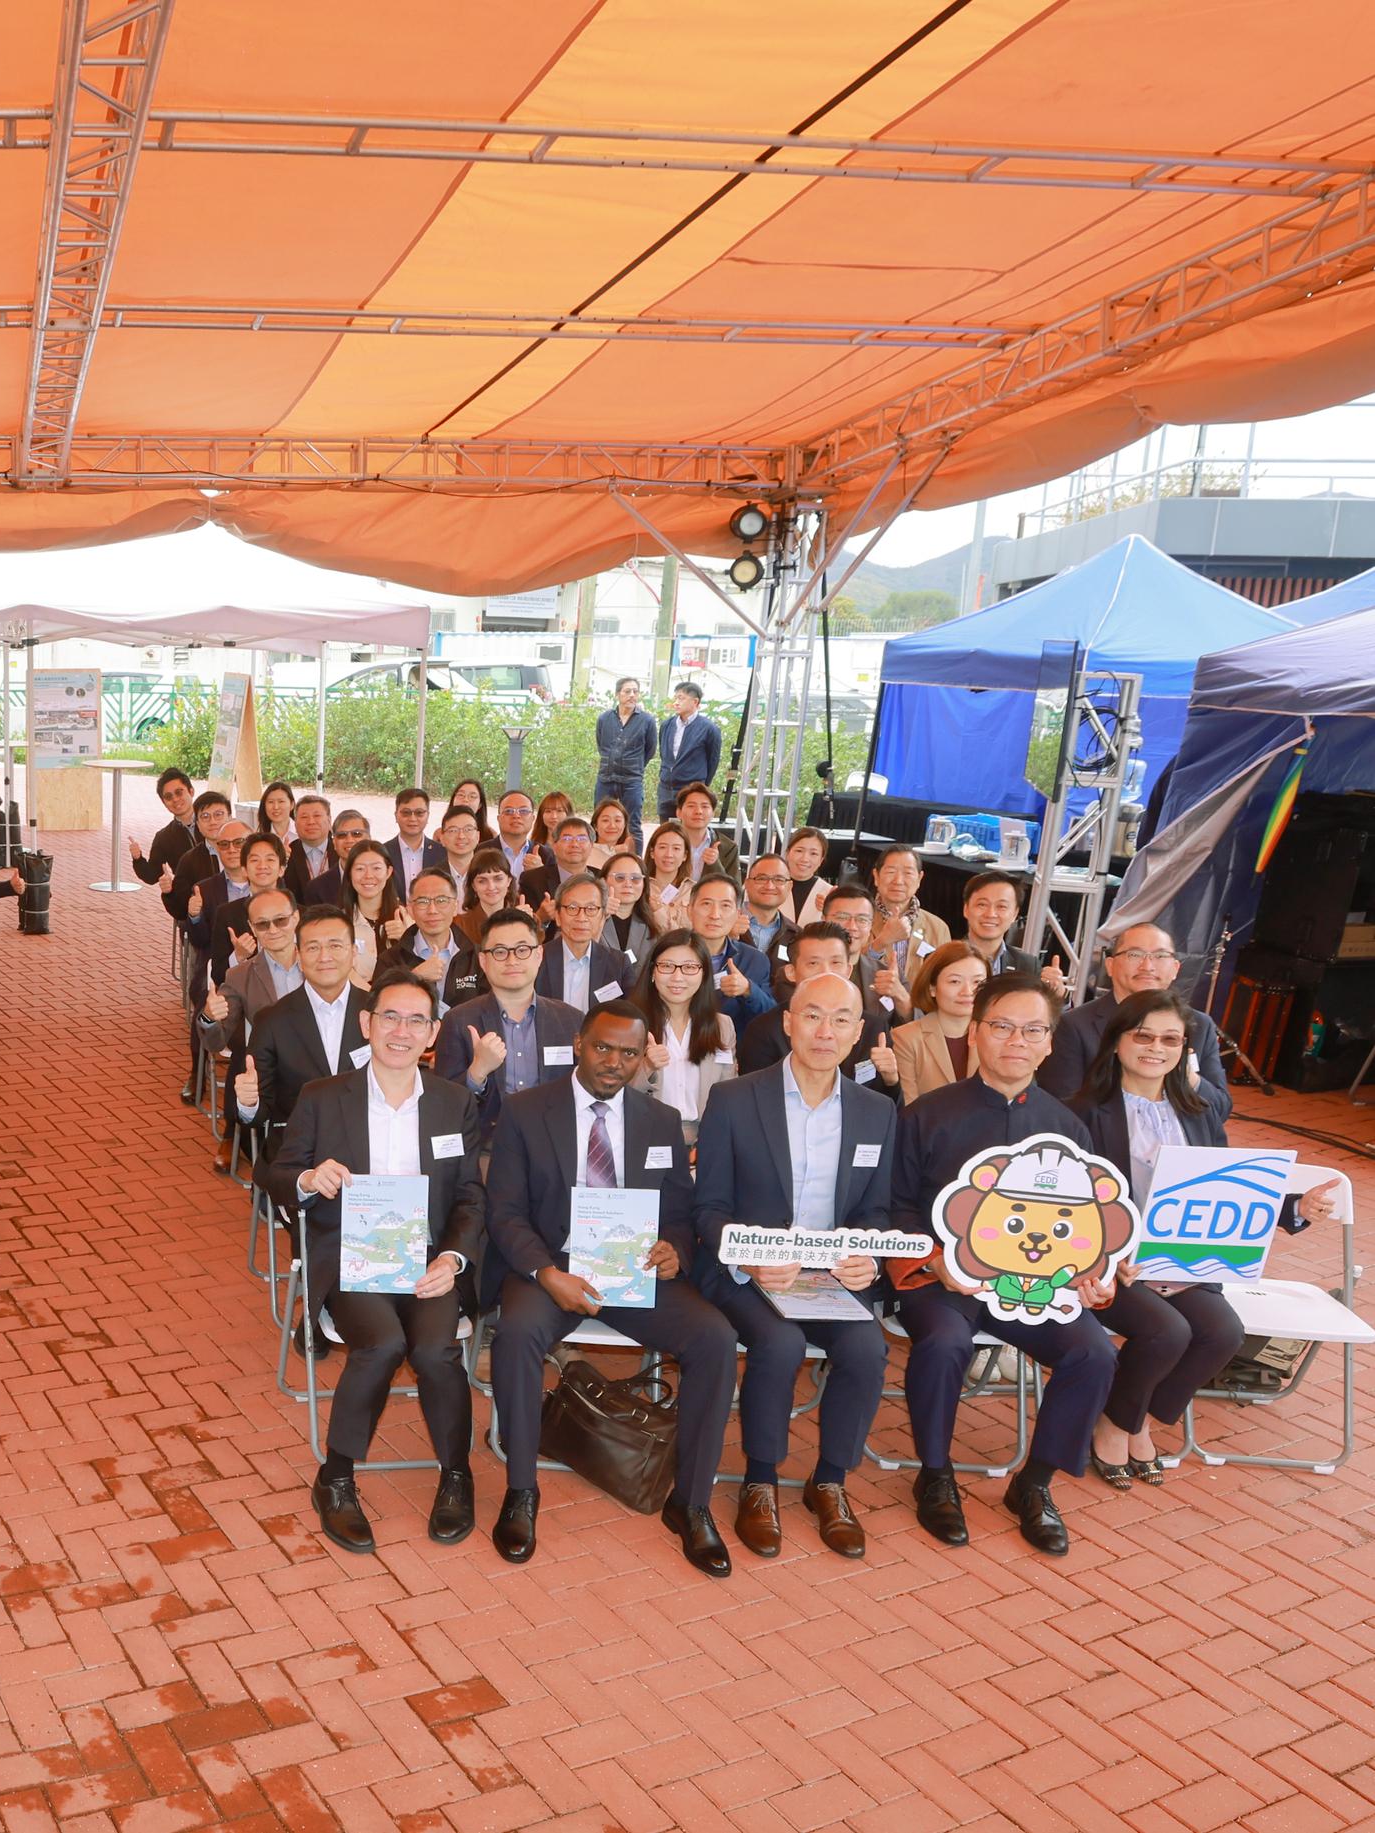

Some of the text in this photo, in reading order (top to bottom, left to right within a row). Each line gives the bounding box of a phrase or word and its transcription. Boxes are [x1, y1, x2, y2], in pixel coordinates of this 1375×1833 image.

[1034, 1175, 1058, 1185] CEDD
[1146, 1198, 1275, 1241] CEDD
[728, 1231, 927, 1252] Nature-based Solutions
[726, 1247, 842, 1263] 基於自然的解決方案
